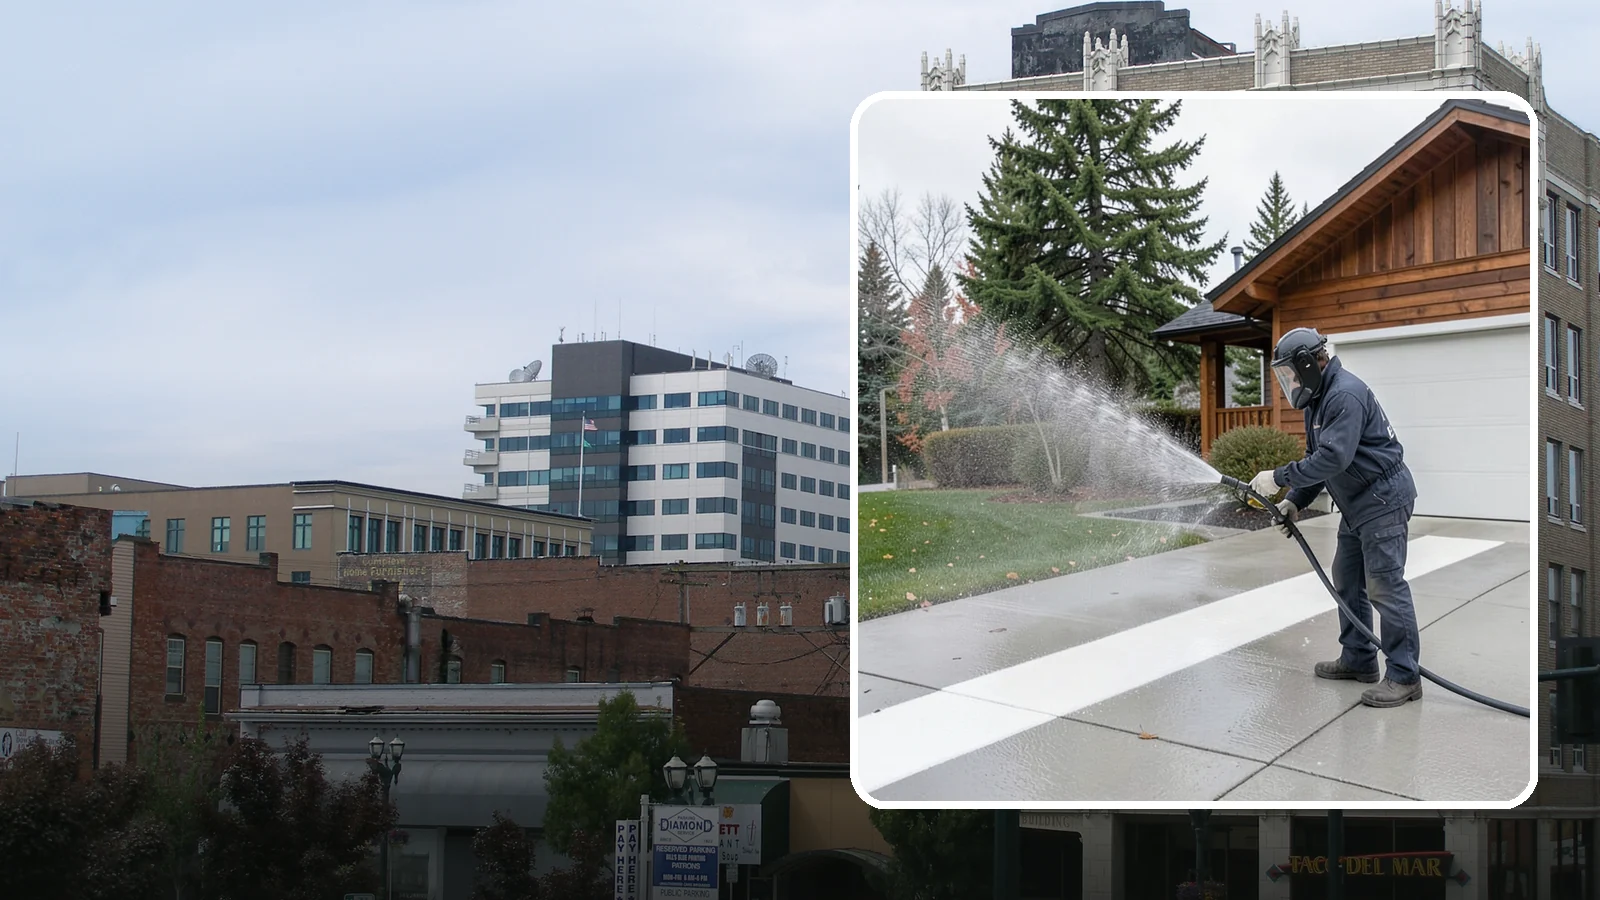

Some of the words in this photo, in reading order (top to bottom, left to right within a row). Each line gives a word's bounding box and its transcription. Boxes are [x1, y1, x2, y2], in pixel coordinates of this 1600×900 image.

[343, 567, 368, 577] Home
[370, 565, 428, 577] Furnishers
[660, 818, 713, 833] DIAMOND
[1022, 815, 1070, 828] BUILDING
[617, 825, 625, 852] PAY
[628, 824, 637, 852] PAY
[656, 845, 688, 853] RESERVED
[689, 846, 716, 854] PARKING
[721, 852, 739, 862] Soup
[671, 862, 701, 870] PATRONS
[1346, 856, 1385, 875] DEL
[1392, 857, 1442, 877] MAR
[616, 856, 625, 893] HERE
[627, 856, 636, 893] HERE
[660, 889, 682, 897] PUBLIC
[683, 890, 710, 898] PARKING
